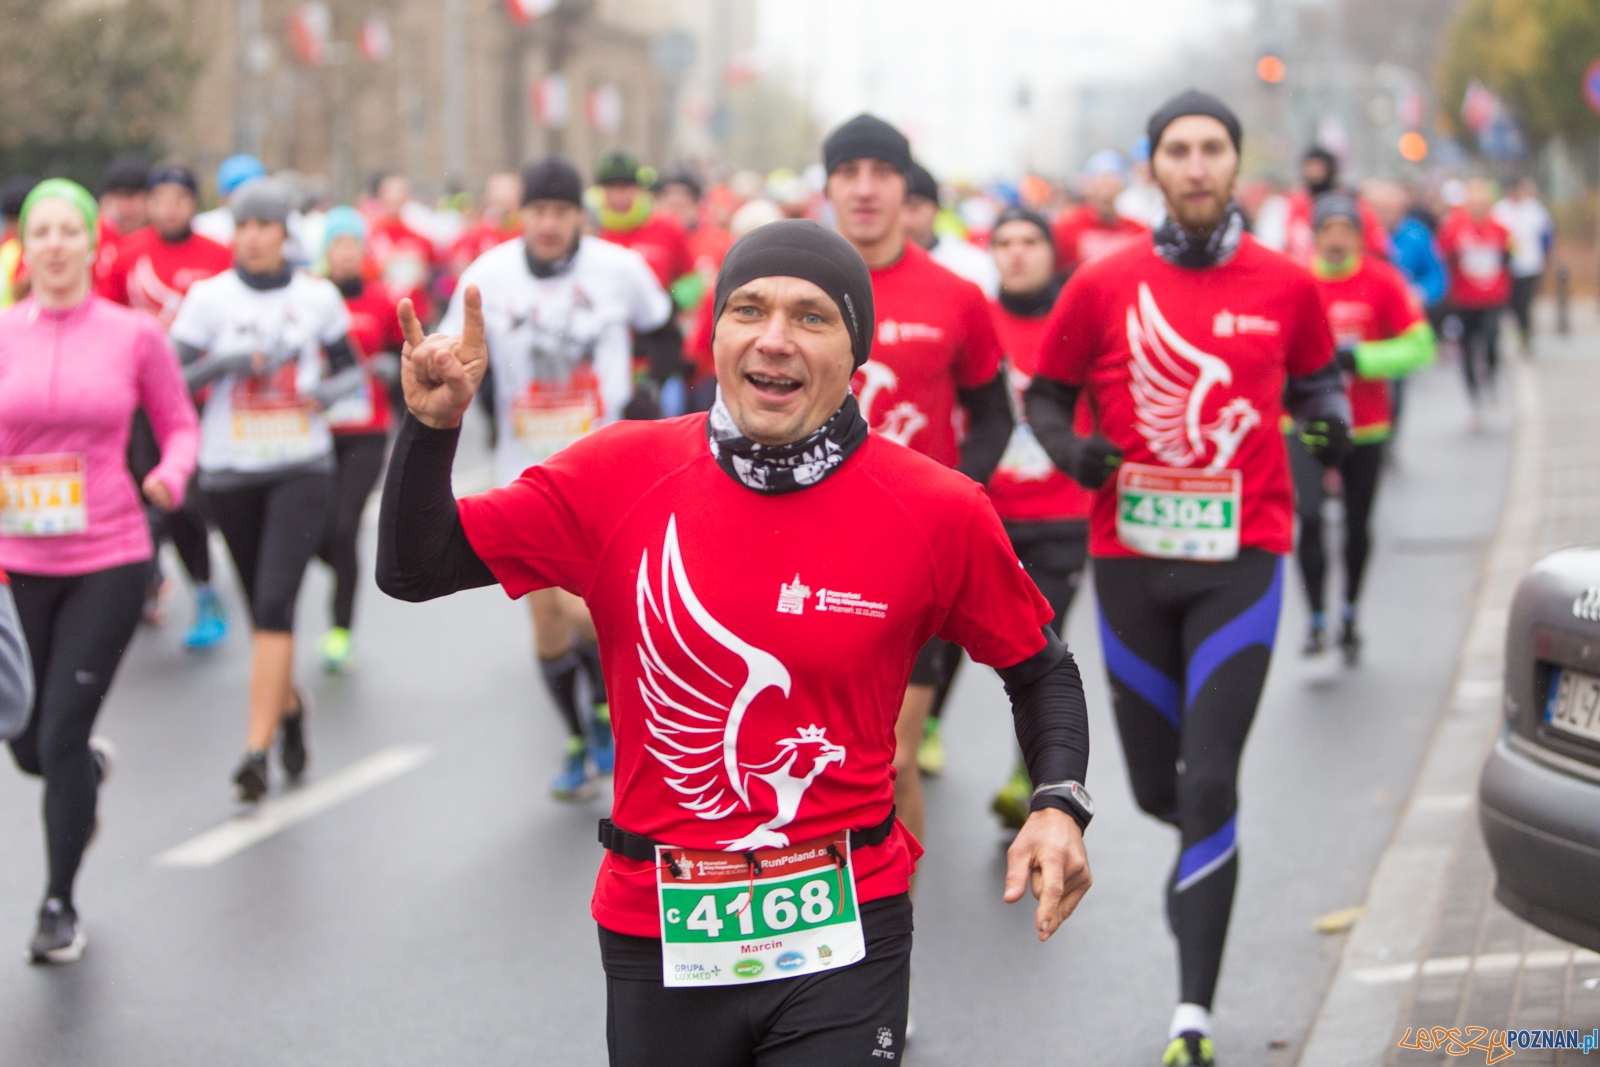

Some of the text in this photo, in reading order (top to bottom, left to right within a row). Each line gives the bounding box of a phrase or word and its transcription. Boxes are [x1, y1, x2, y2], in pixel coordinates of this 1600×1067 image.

[1133, 495, 1227, 528] 4304
[815, 588, 827, 611] 1
[696, 861, 706, 876] 1
[686, 879, 834, 938] 4168
[741, 940, 783, 954] Marcin
[674, 964, 705, 972] GRUPA
[674, 972, 711, 981] LUXMED
